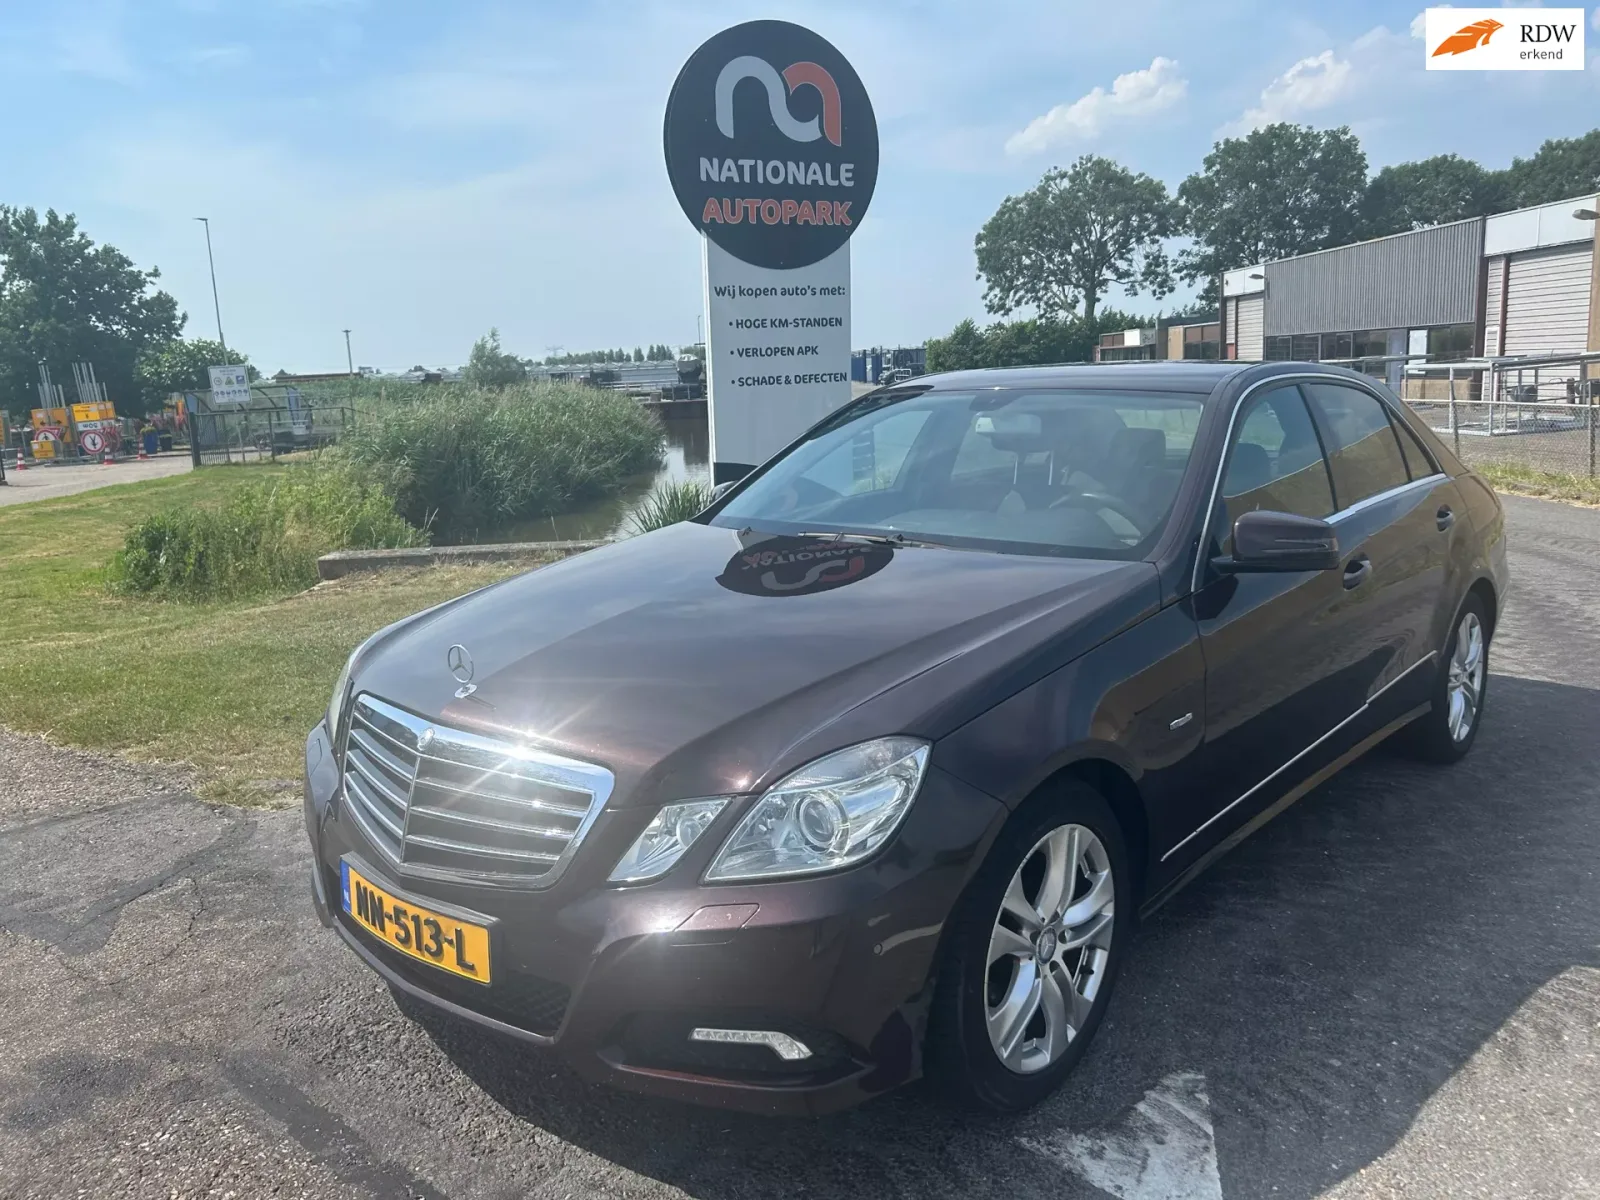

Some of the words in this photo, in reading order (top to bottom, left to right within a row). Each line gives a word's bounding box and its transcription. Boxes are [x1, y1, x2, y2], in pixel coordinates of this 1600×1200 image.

[699, 157, 855, 187] NATIONALE
[702, 197, 853, 226] AUTOPARK
[714, 285, 736, 299] Wij
[738, 285, 778, 299] kopen
[780, 285, 817, 296] auto's
[819, 286, 846, 296] met:
[735, 318, 768, 329] HOGE
[770, 317, 843, 329] KM-STANDEN
[736, 346, 795, 358] VERLOPEN
[796, 345, 819, 356] APK
[738, 376, 782, 387] SCHADE
[784, 376, 792, 385] &
[794, 372, 848, 385] DEFECTEN
[355, 879, 475, 971] NN-513-L
